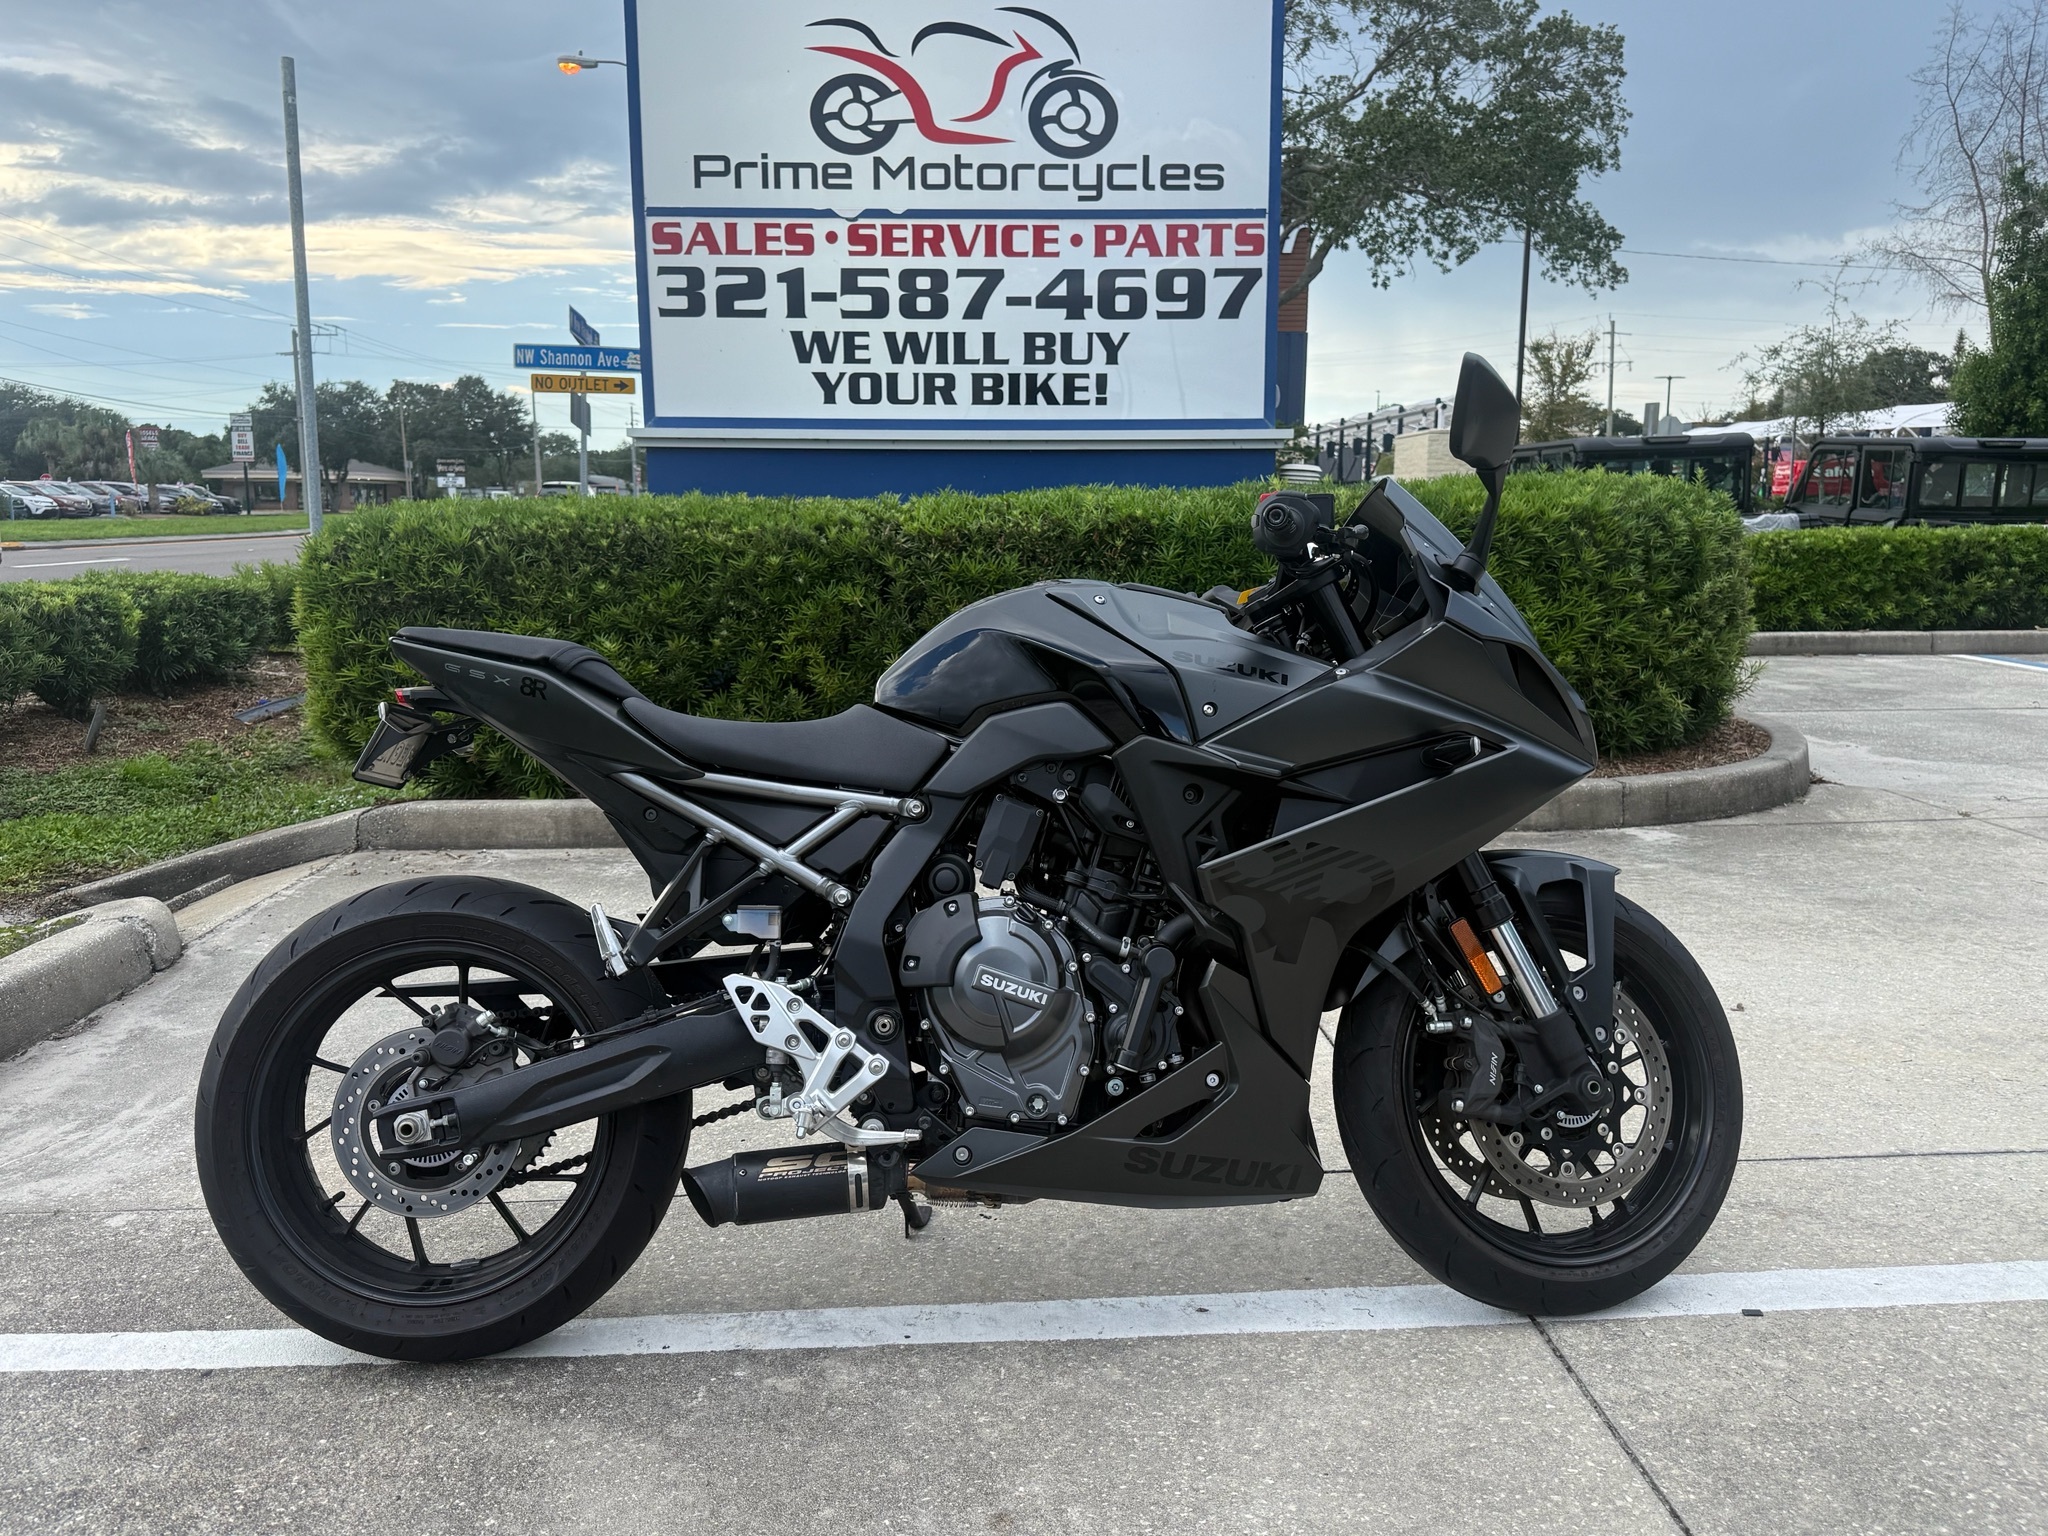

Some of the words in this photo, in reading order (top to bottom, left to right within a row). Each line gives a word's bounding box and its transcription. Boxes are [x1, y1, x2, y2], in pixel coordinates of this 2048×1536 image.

[693, 153, 853, 190] Prime
[872, 154, 1225, 202] Motorcycles
[652, 222, 815, 256] SALES
[846, 223, 1060, 258] SERVICE
[1093, 223, 1265, 258] PARTS
[657, 266, 1263, 321] 321-587-4697
[516, 348, 535, 365] NW
[540, 348, 592, 367] Shannon
[597, 351, 620, 368] Ave
[790, 331, 871, 365] WE
[883, 331, 1010, 365] WILL
[1023, 332, 1130, 366] BUY
[535, 376, 553, 390] NO
[559, 377, 609, 392] OUTLET
[811, 372, 957, 406] YOUR
[971, 372, 1108, 406] BIKE!
[1171, 650, 1289, 687] SUZUKI
[520, 676, 548, 701] 8R
[980, 973, 1048, 1006] SUZUKI
[1124, 1146, 1303, 1191] SUZUKI
